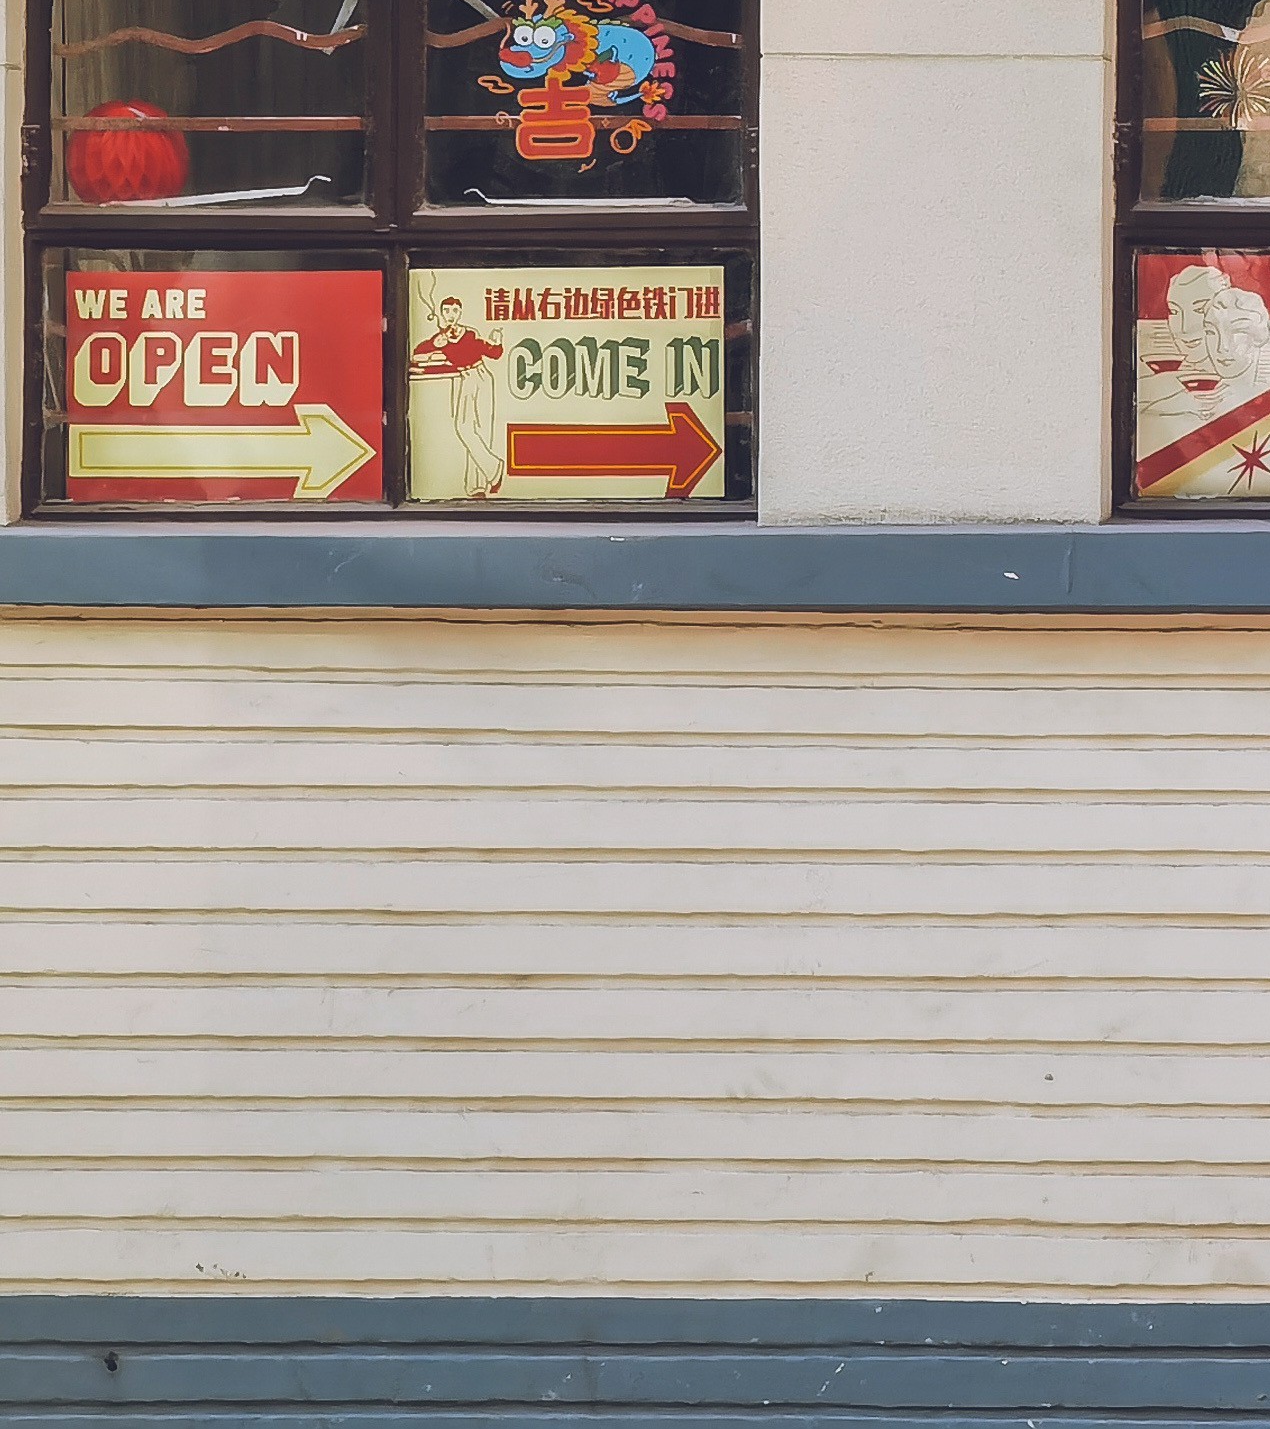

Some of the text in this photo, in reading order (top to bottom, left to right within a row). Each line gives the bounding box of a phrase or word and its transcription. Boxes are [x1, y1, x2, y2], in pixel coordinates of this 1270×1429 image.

[515, 74, 596, 160] 吉
[74, 289, 207, 320] WE ARE
[485, 286, 722, 321] 请从右边绿色铁门进
[74, 331, 299, 407] OPEN
[507, 336, 721, 401] COME IN
